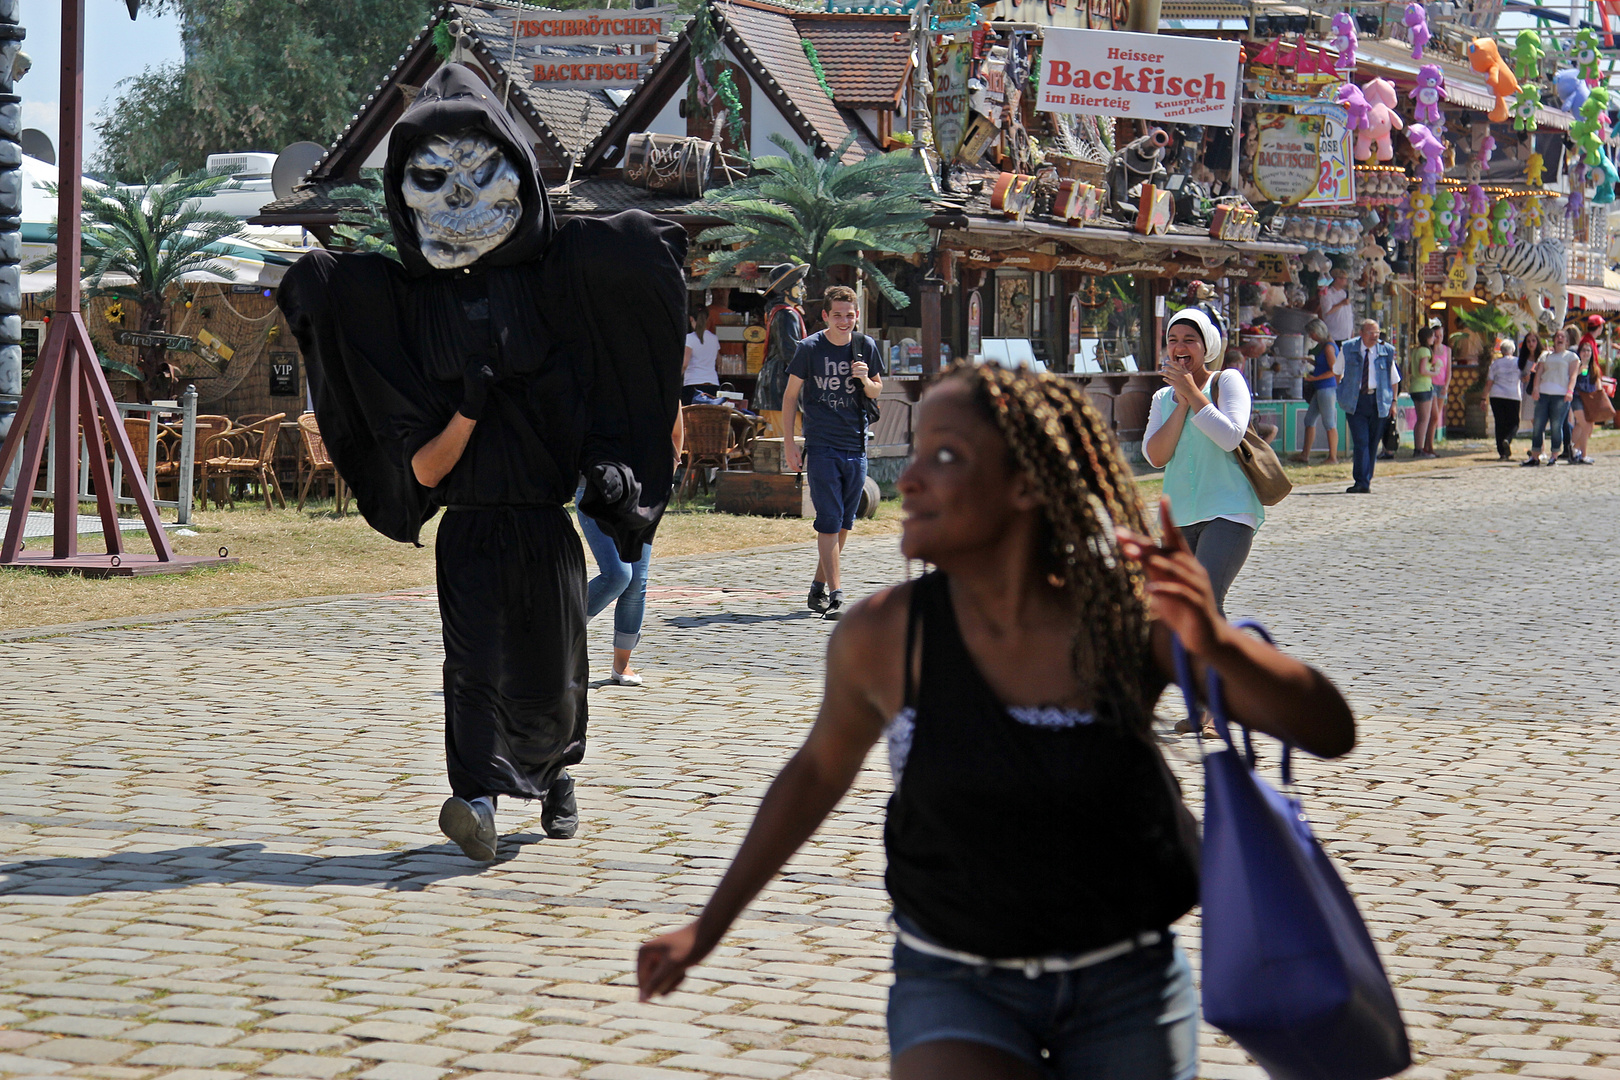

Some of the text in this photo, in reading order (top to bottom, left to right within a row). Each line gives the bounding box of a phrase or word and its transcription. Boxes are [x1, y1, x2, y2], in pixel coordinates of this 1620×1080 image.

[512, 15, 662, 37] FISCHBRÖTCHEN
[1107, 48, 1164, 63] Heisser
[533, 63, 639, 81] BACKFISCH
[1046, 60, 1226, 99] Backfisch
[937, 75, 950, 91] 20
[1045, 92, 1130, 111] im Bierteig
[1155, 95, 1207, 109] Knusprig
[1164, 103, 1225, 117] und Lecker
[1258, 151, 1317, 169] BACKFISCHE
[273, 364, 293, 375] VIP
[813, 375, 857, 394] we g
